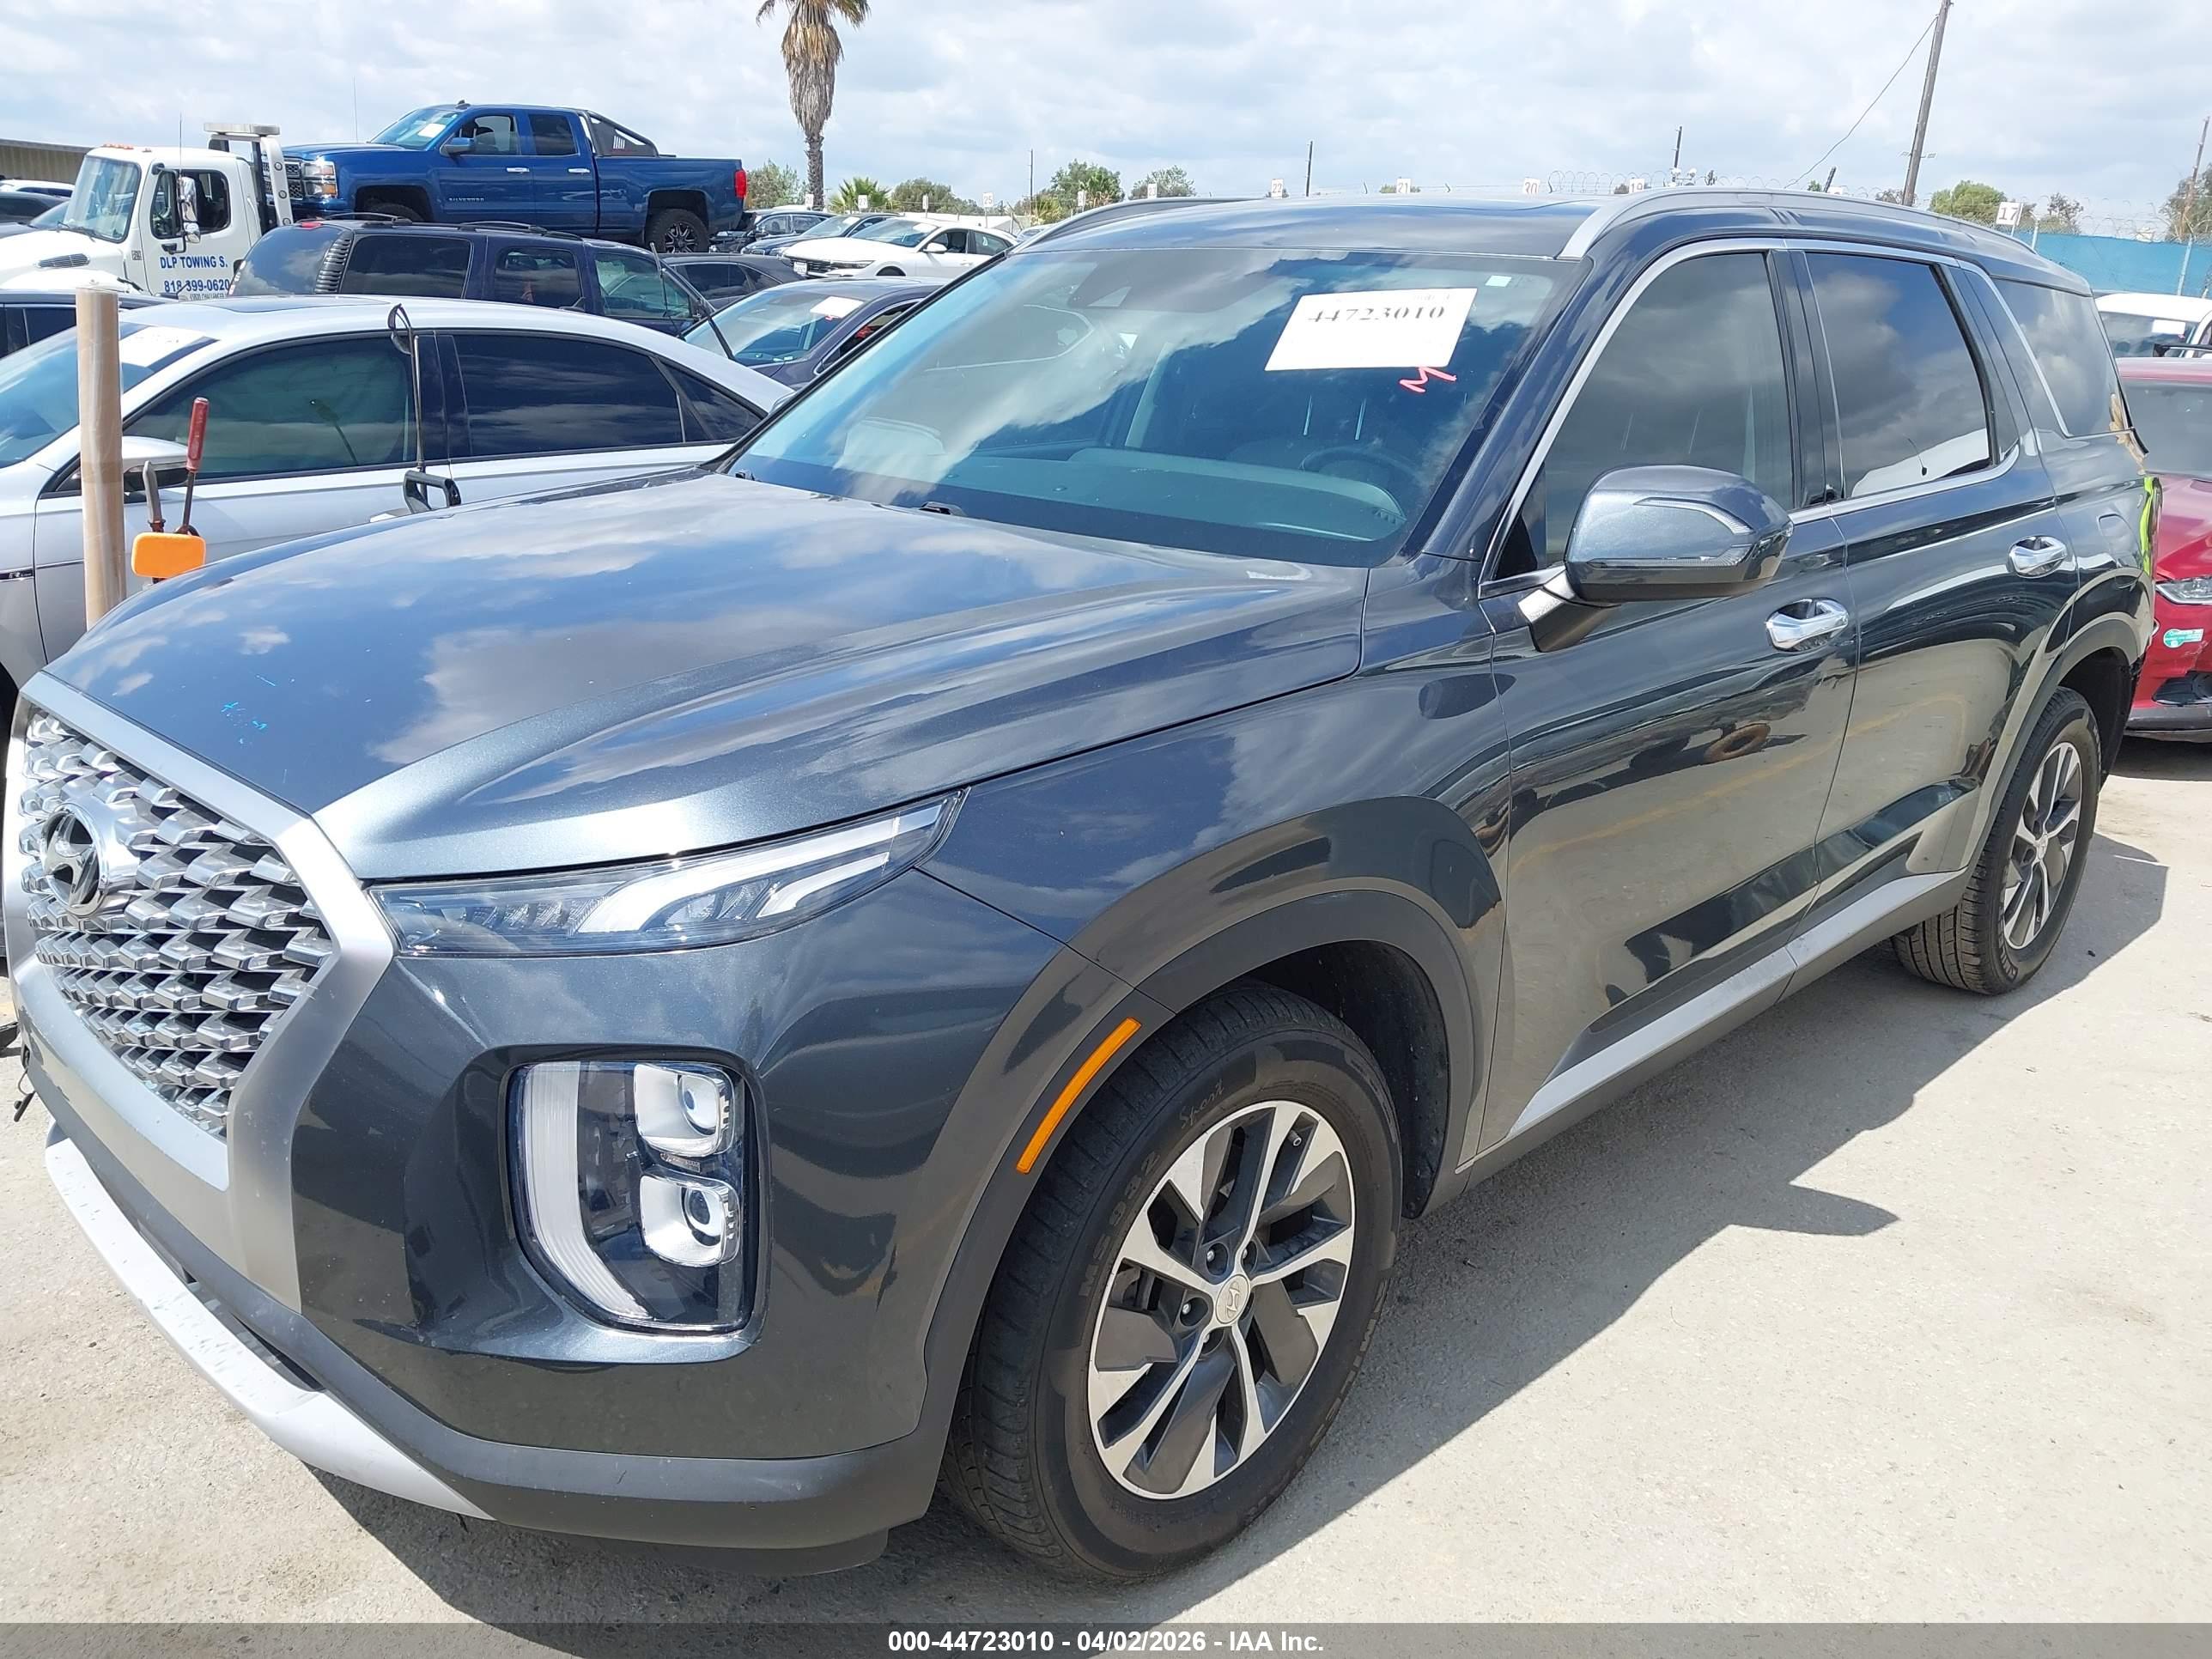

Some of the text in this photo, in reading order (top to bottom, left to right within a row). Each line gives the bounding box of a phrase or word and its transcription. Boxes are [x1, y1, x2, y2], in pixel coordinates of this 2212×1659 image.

[1272, 183, 1283, 193] 22
[983, 195, 993, 205] 25
[1999, 206, 2019, 221] 17
[160, 256, 228, 269] DLP TOWING S.
[164, 278, 230, 293] 818 399-0620
[1307, 306, 1445, 323] 44723010
